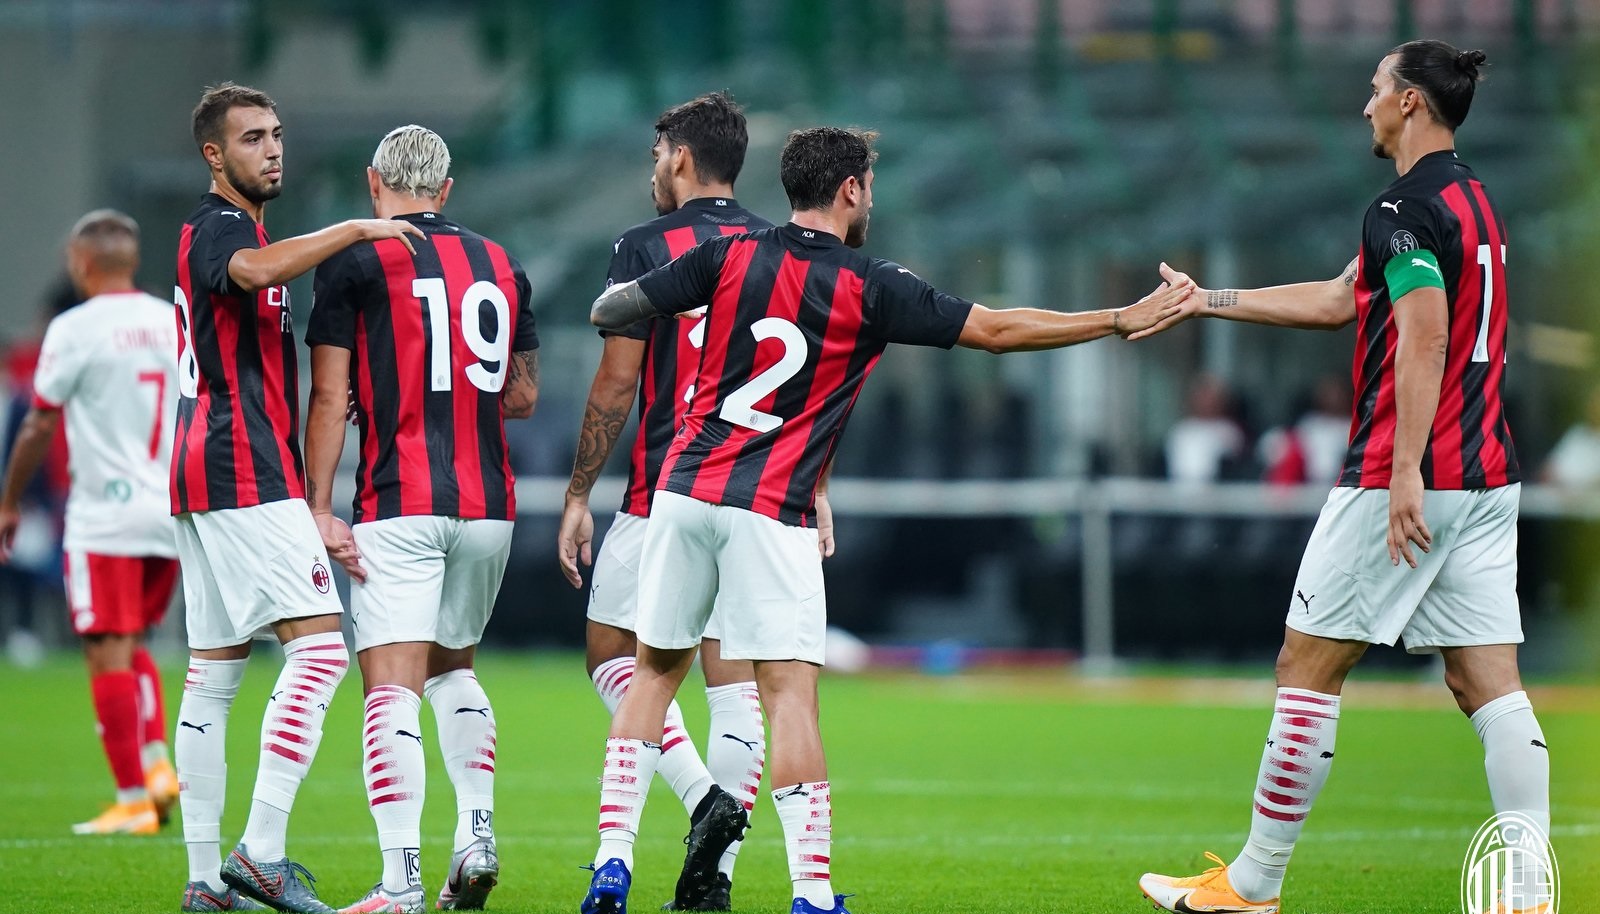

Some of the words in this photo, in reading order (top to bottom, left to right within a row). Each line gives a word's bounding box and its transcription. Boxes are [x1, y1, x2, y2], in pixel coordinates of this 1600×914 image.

[412, 278, 511, 393] 19
[719, 316, 809, 434] 2
[136, 369, 166, 461] 7
